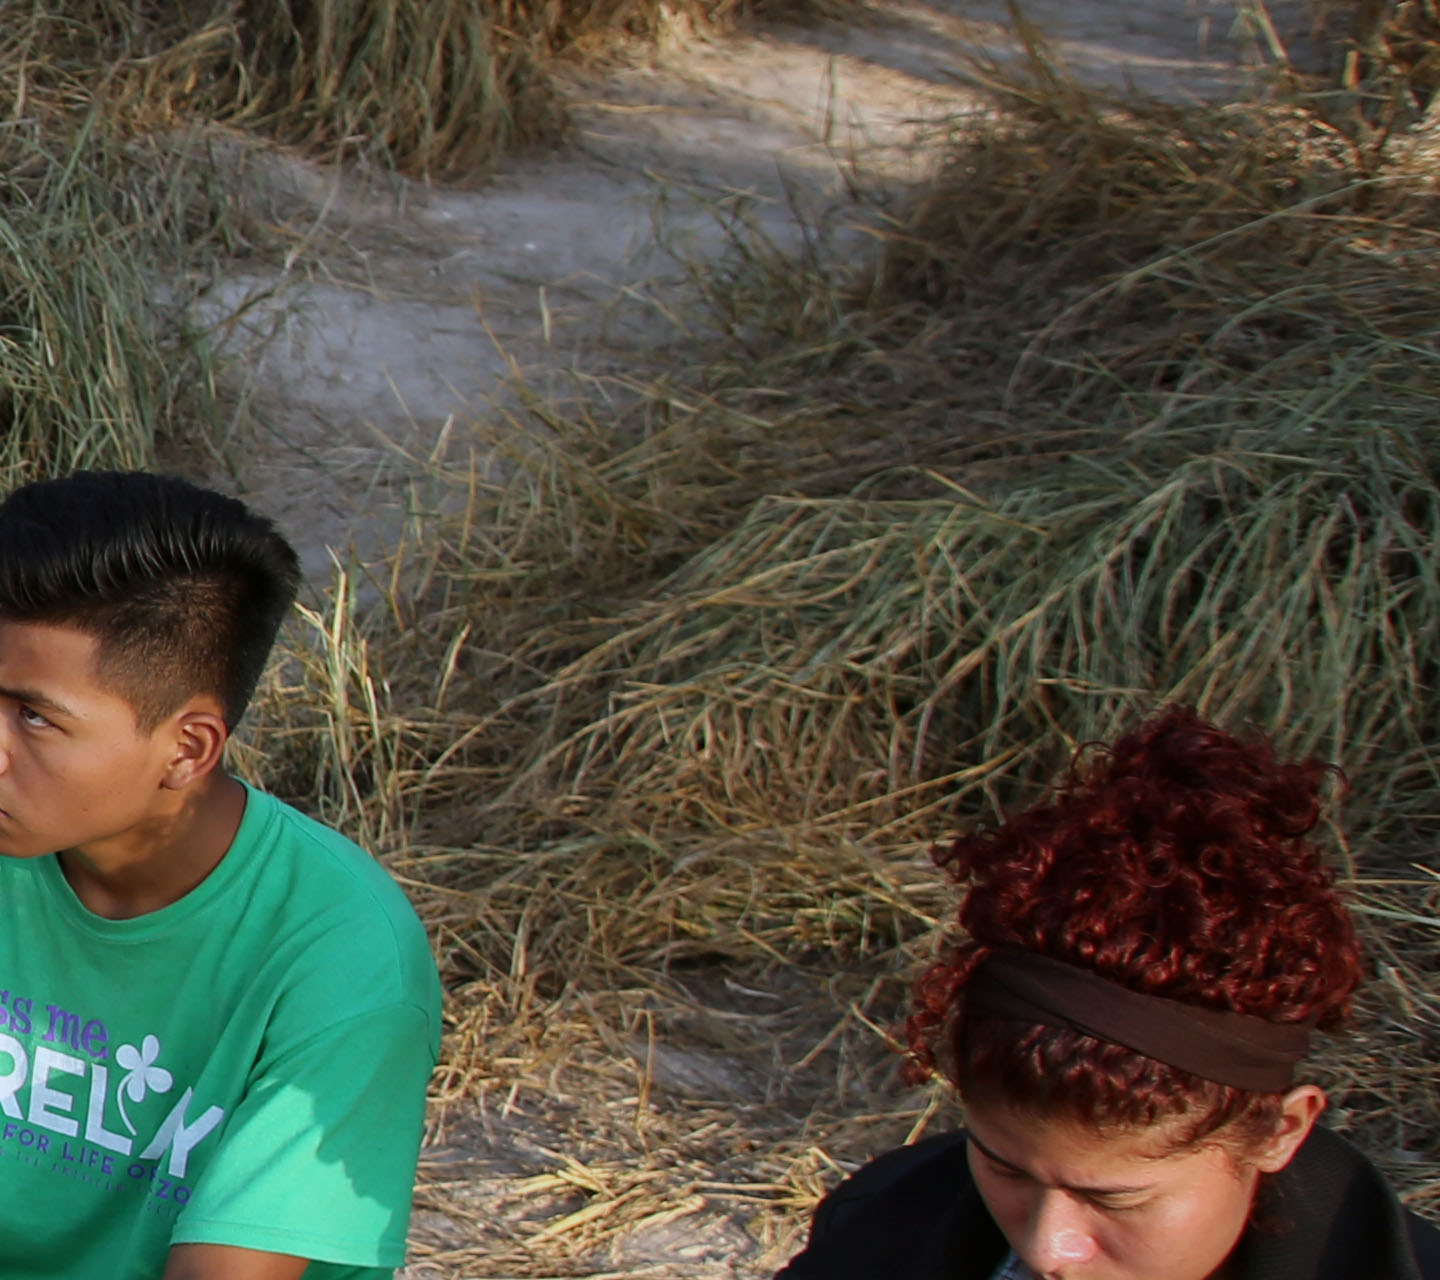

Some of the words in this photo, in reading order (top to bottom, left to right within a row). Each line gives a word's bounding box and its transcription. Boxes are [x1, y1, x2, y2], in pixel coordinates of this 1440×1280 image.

[42, 1004, 109, 1059] me
[3, 1123, 50, 1154] FOR
[63, 1141, 117, 1176] LIFE
